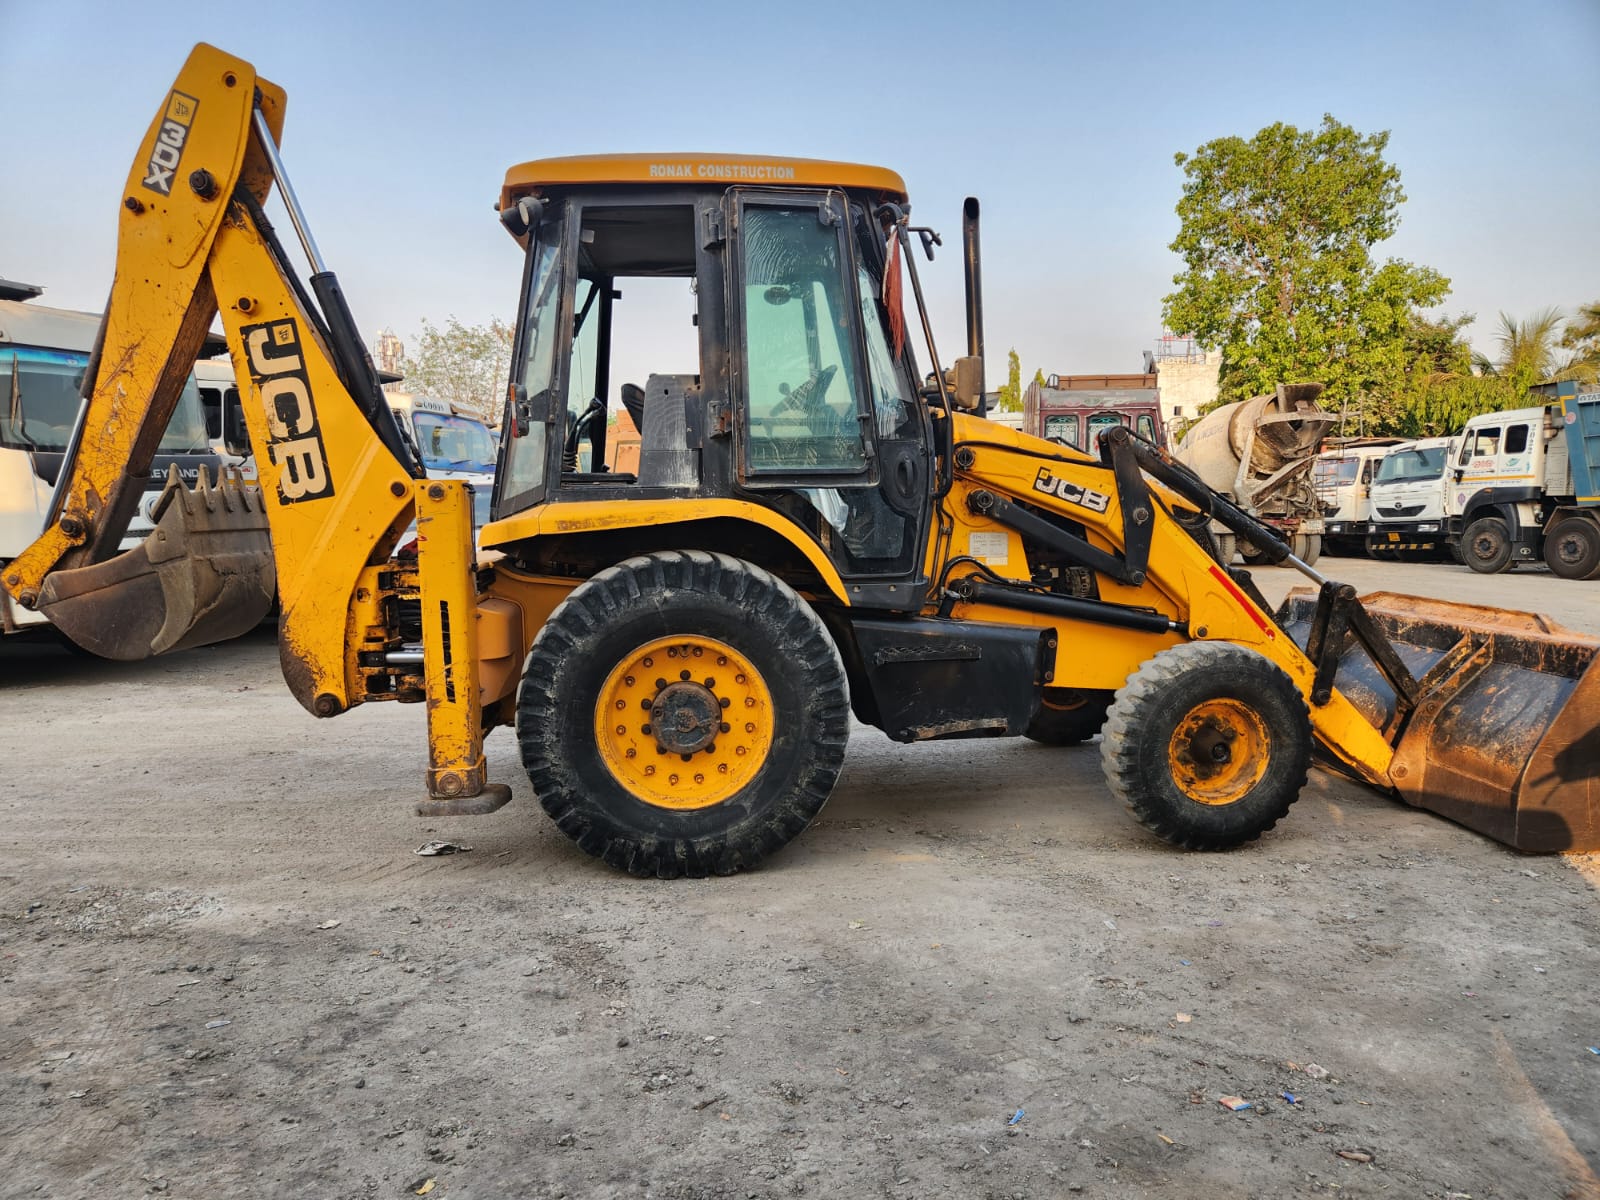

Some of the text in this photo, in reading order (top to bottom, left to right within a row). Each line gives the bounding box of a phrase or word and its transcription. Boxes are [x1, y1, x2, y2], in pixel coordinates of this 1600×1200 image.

[144, 121, 187, 193] 3DX
[650, 164, 795, 179] RONAK CONSTRUCTION
[248, 323, 328, 499] JCB
[151, 468, 200, 479] EYAND
[1036, 475, 1110, 512] JCB
